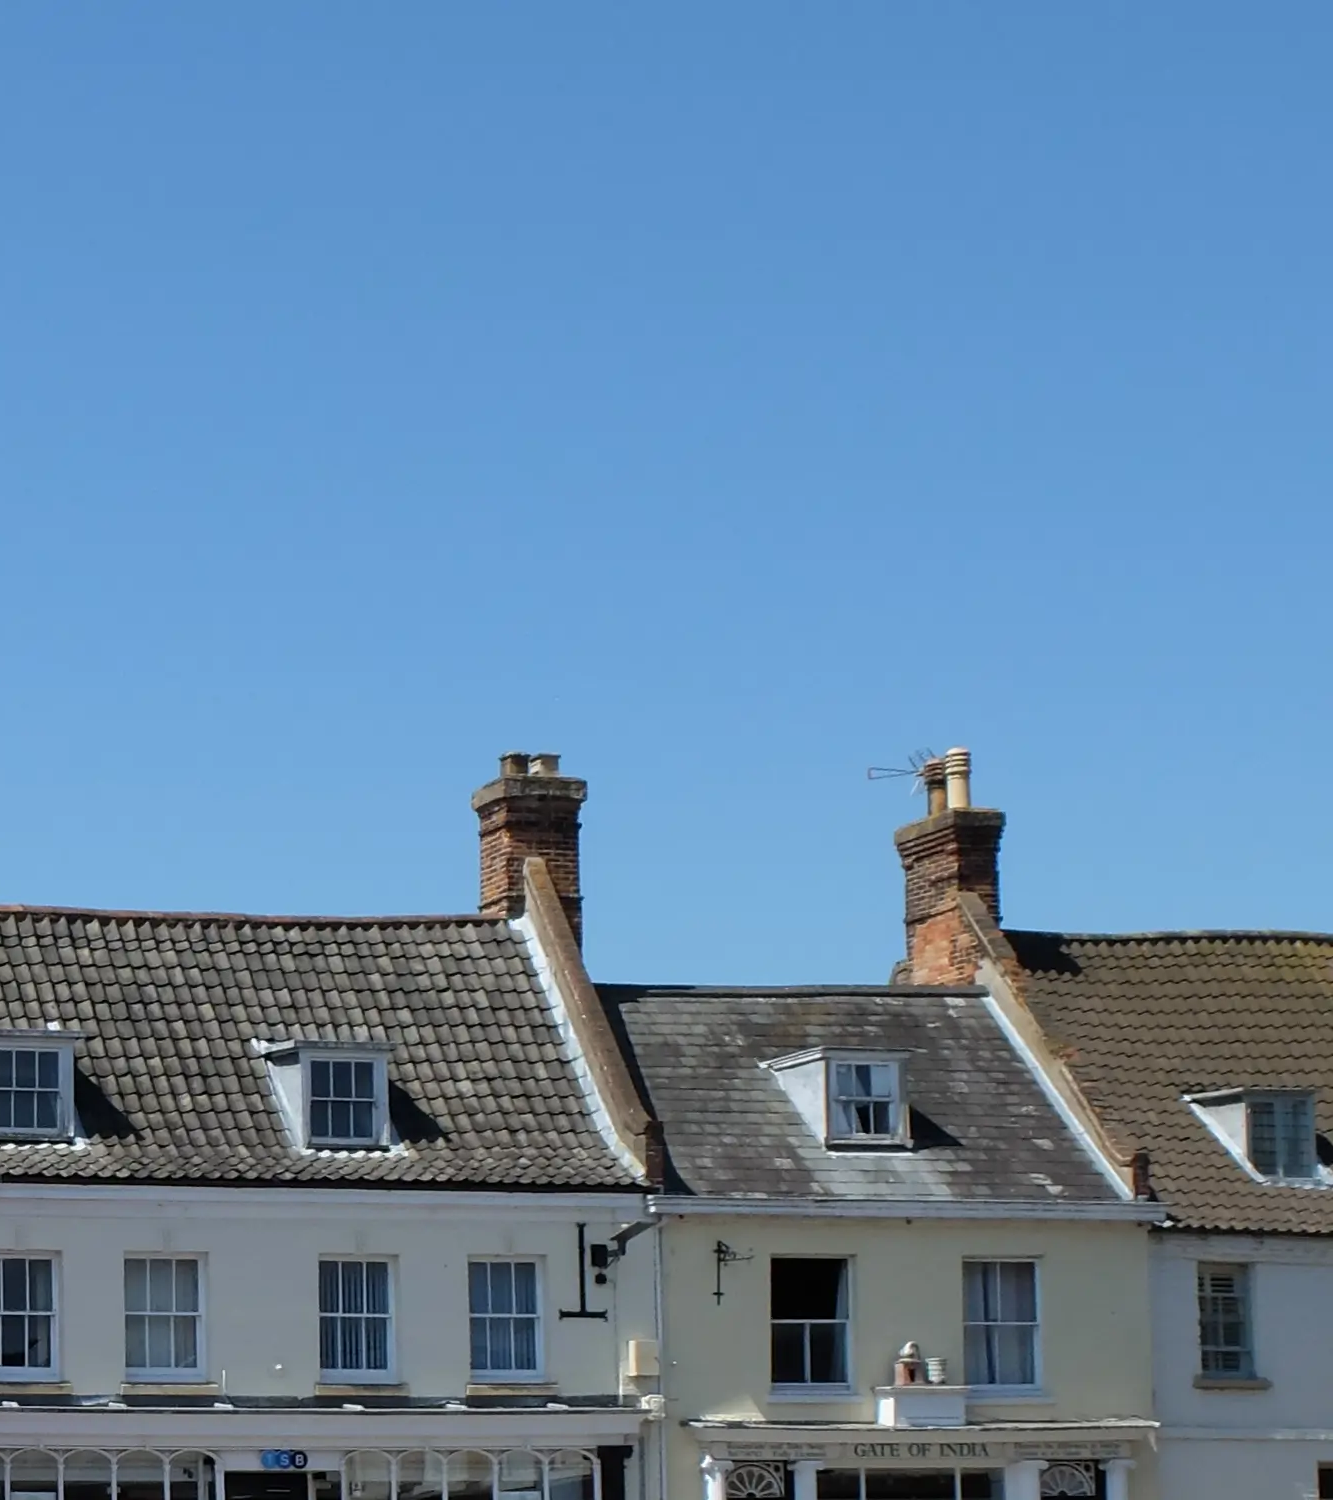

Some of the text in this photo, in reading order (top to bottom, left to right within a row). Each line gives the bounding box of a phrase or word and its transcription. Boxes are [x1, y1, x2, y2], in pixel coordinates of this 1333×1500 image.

[853, 1442, 990, 1458] GATE OF INDIA
[262, 1451, 307, 1468] TSB
